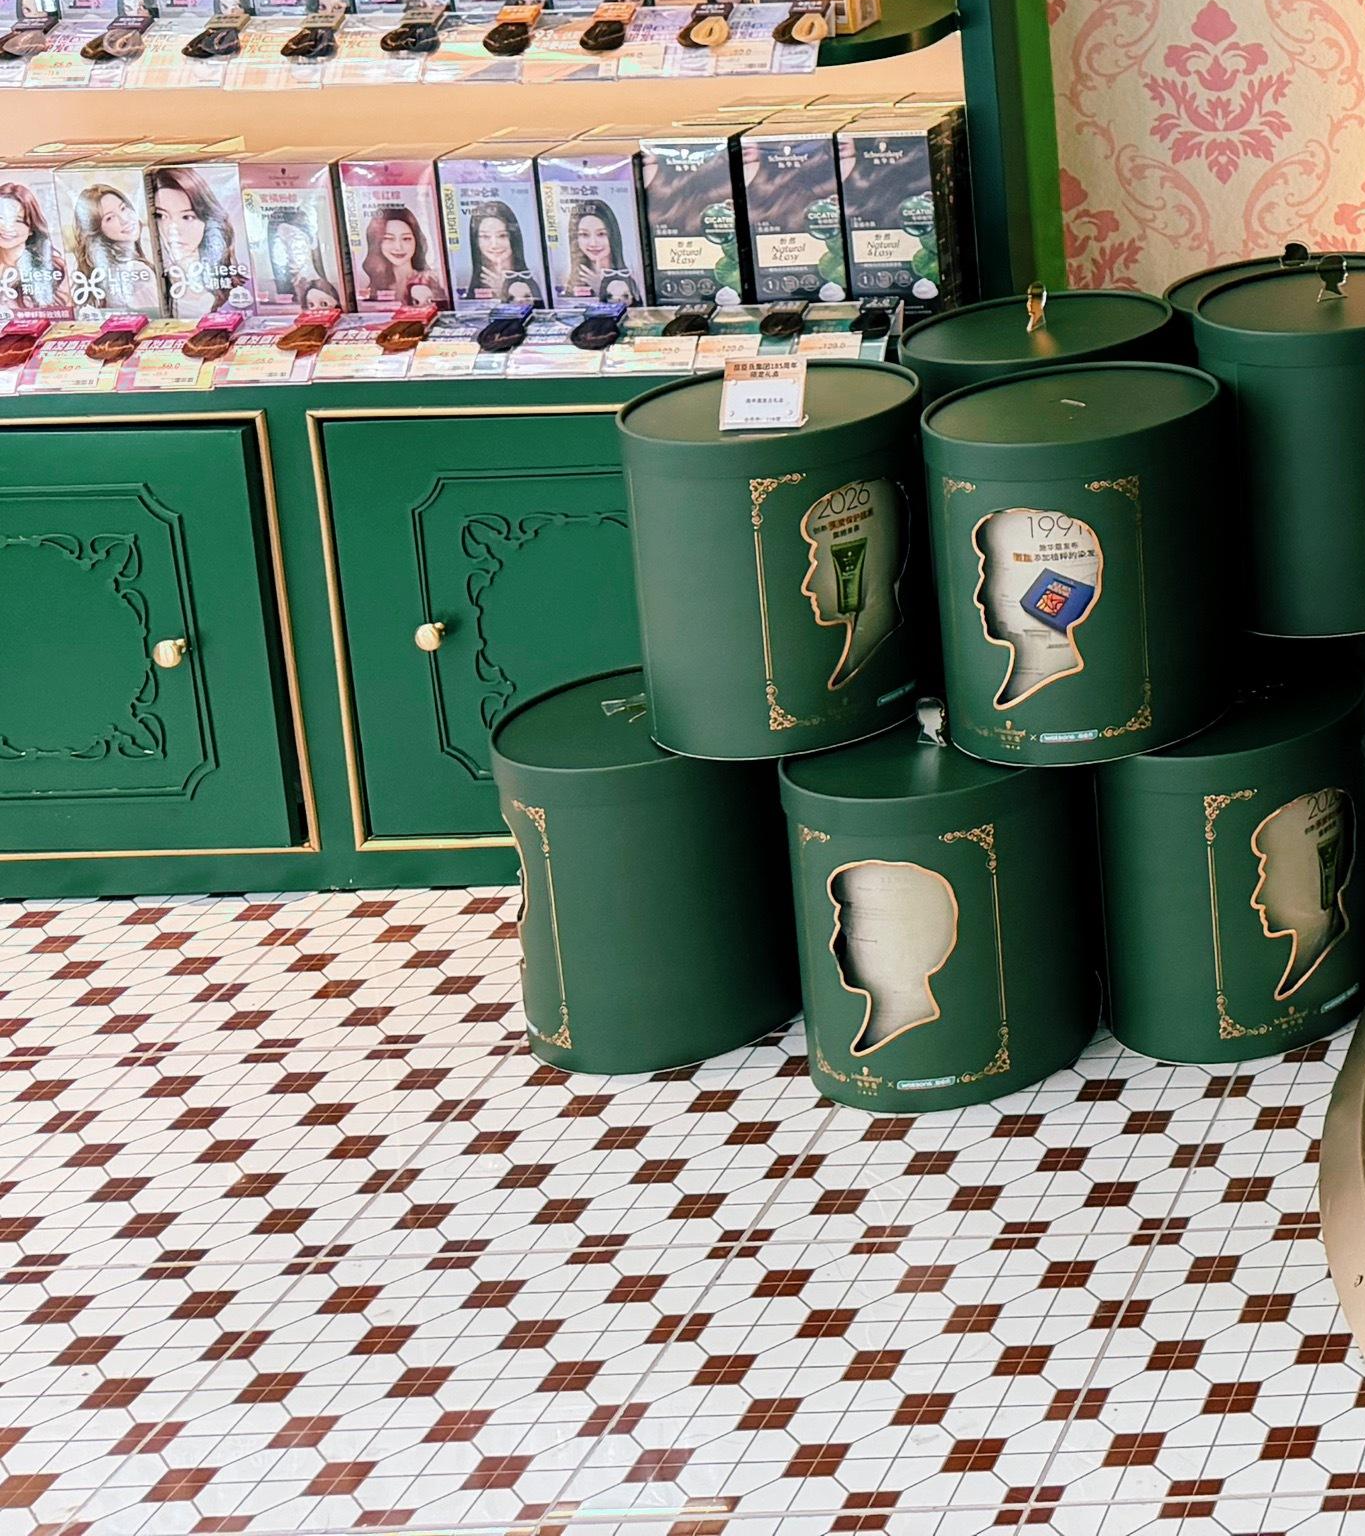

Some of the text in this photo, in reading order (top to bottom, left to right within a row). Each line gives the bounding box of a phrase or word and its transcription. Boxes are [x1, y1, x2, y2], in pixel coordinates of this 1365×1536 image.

[771, 243, 806, 254] Natural
[866, 239, 901, 250] Natural
[669, 247, 703, 257] Natural
[20, 268, 63, 282] Liese
[108, 267, 150, 281] Liese
[205, 264, 249, 277] Liese
[817, 482, 871, 519] 2026
